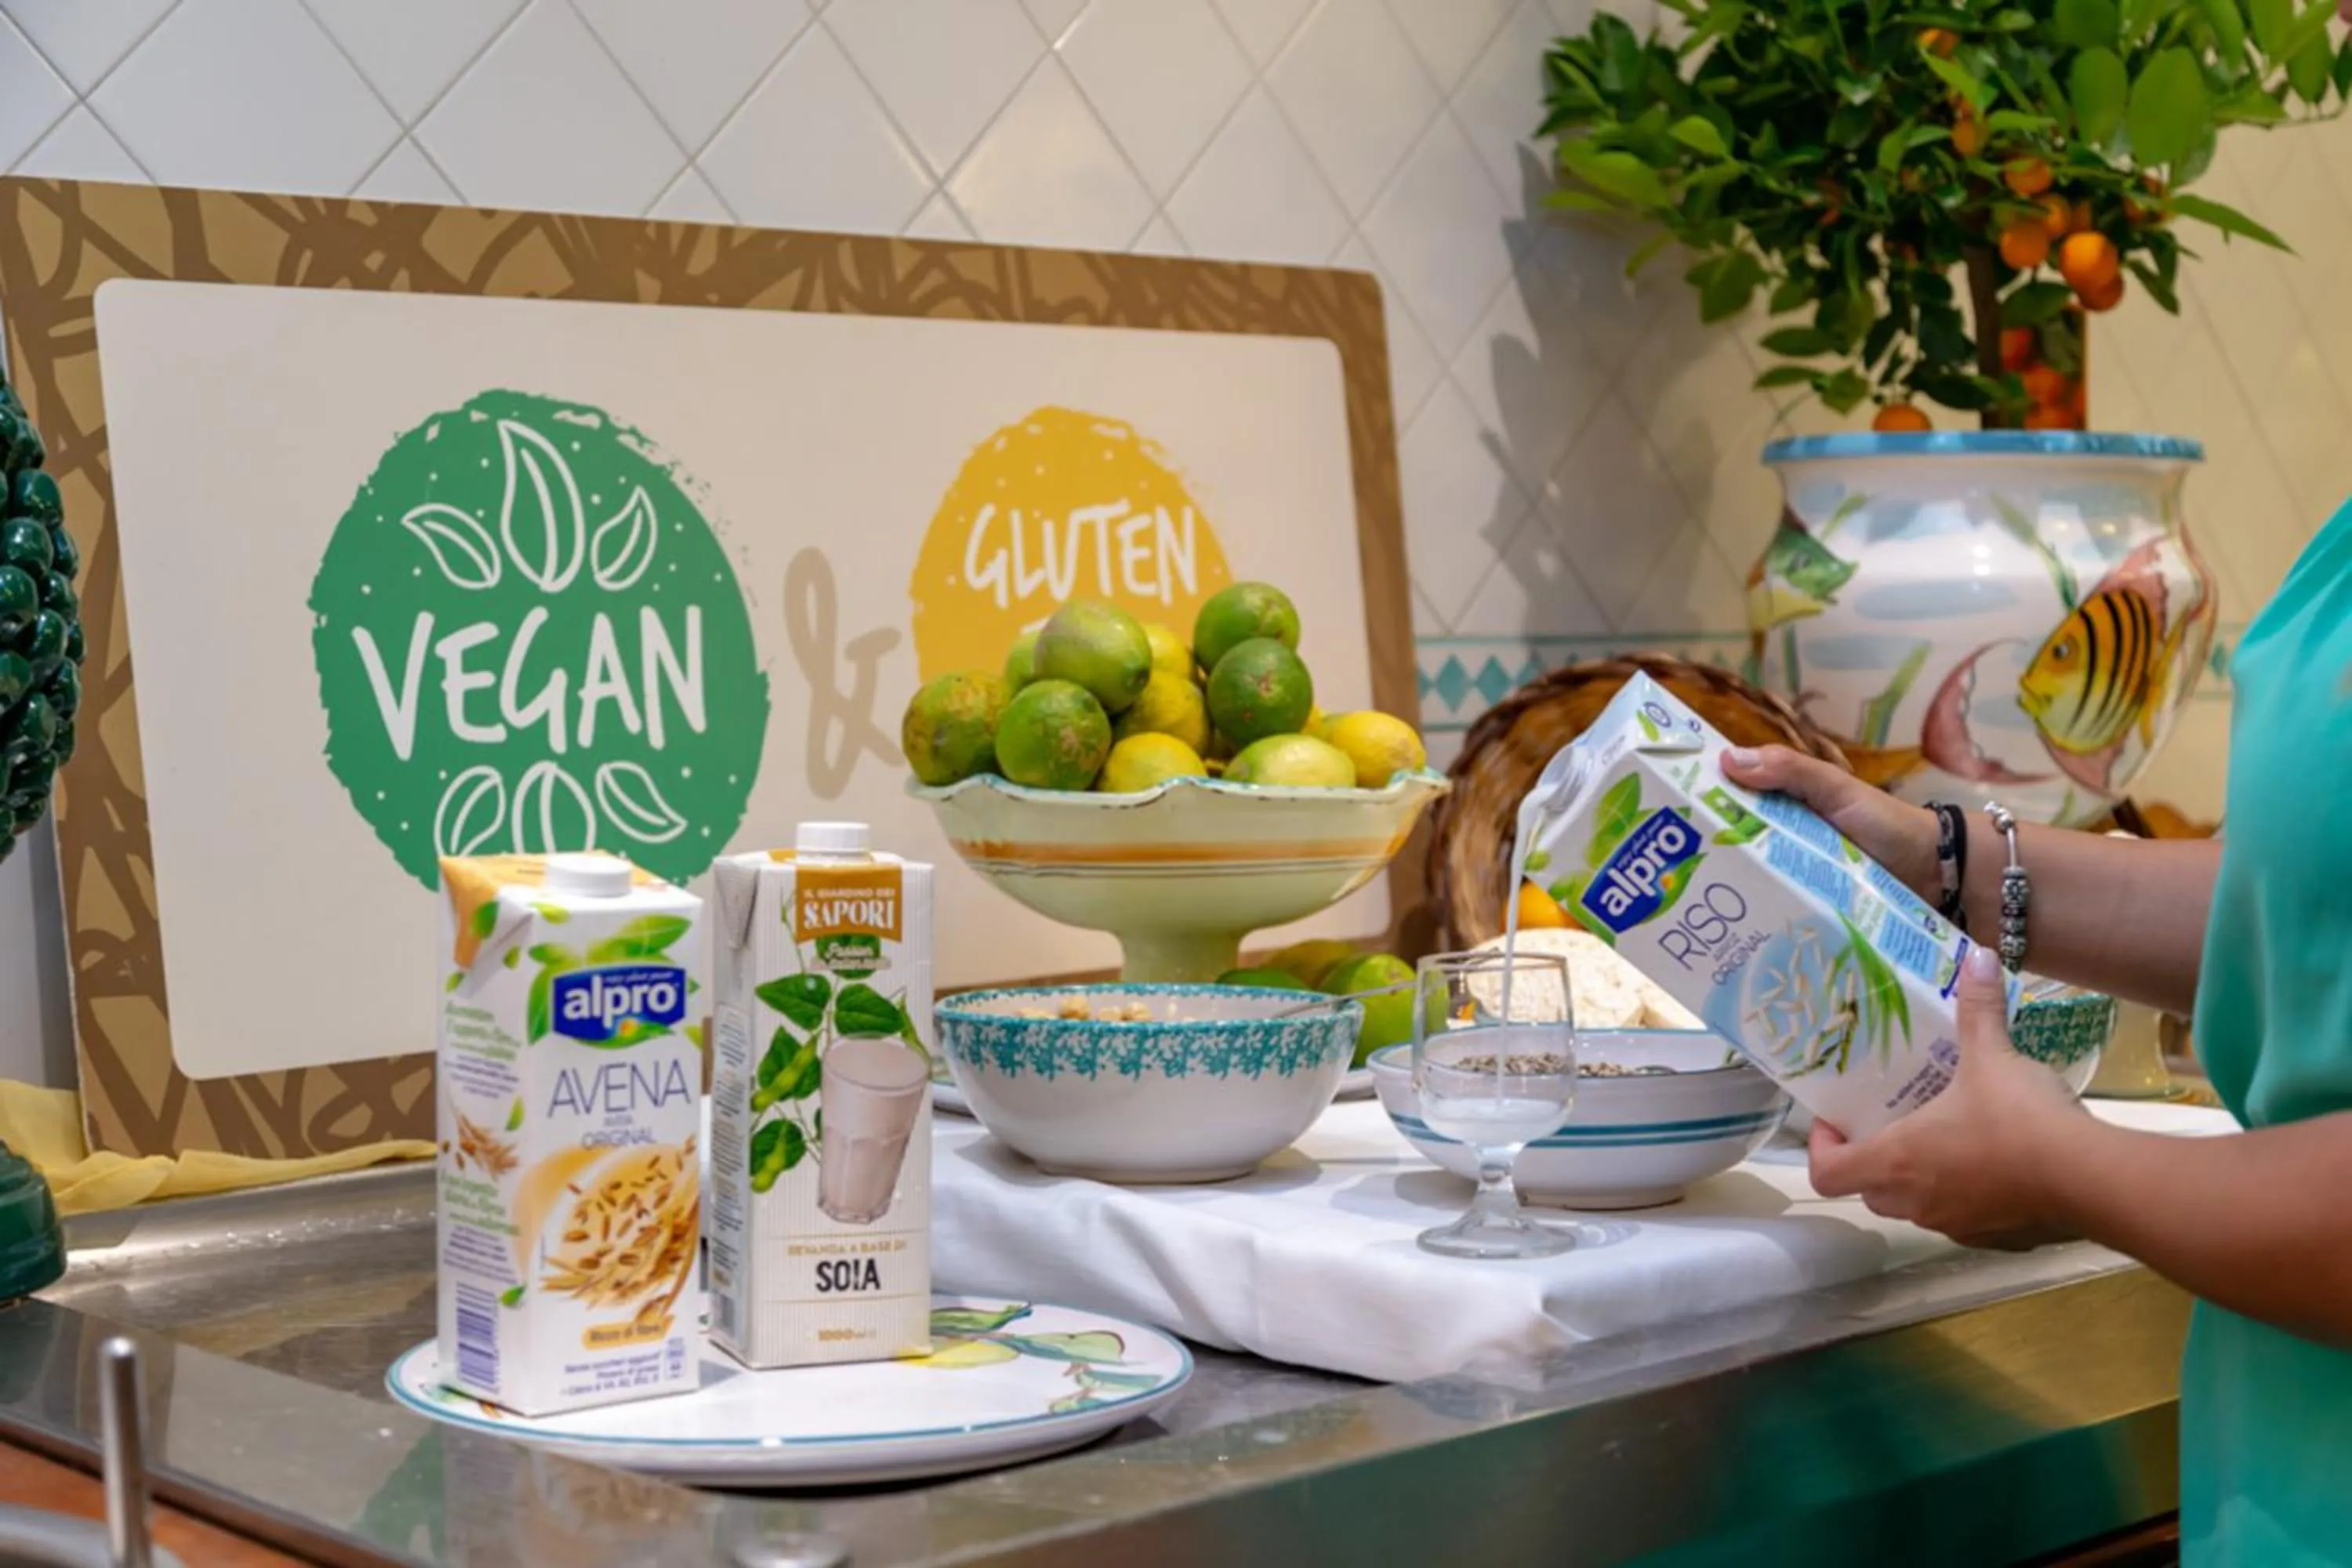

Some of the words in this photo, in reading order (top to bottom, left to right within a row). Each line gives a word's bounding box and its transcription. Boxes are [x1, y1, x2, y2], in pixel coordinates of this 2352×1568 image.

[964, 498, 1197, 609] GLUTEN
[351, 606, 706, 760] VEGAN
[1600, 825, 1686, 916] alpro
[804, 899, 895, 930] SAPORI
[1658, 883, 1747, 971] RISO
[1712, 930, 1772, 985] ORIGINAL
[563, 975, 677, 1029] alpro
[547, 1058, 691, 1119] AVENA
